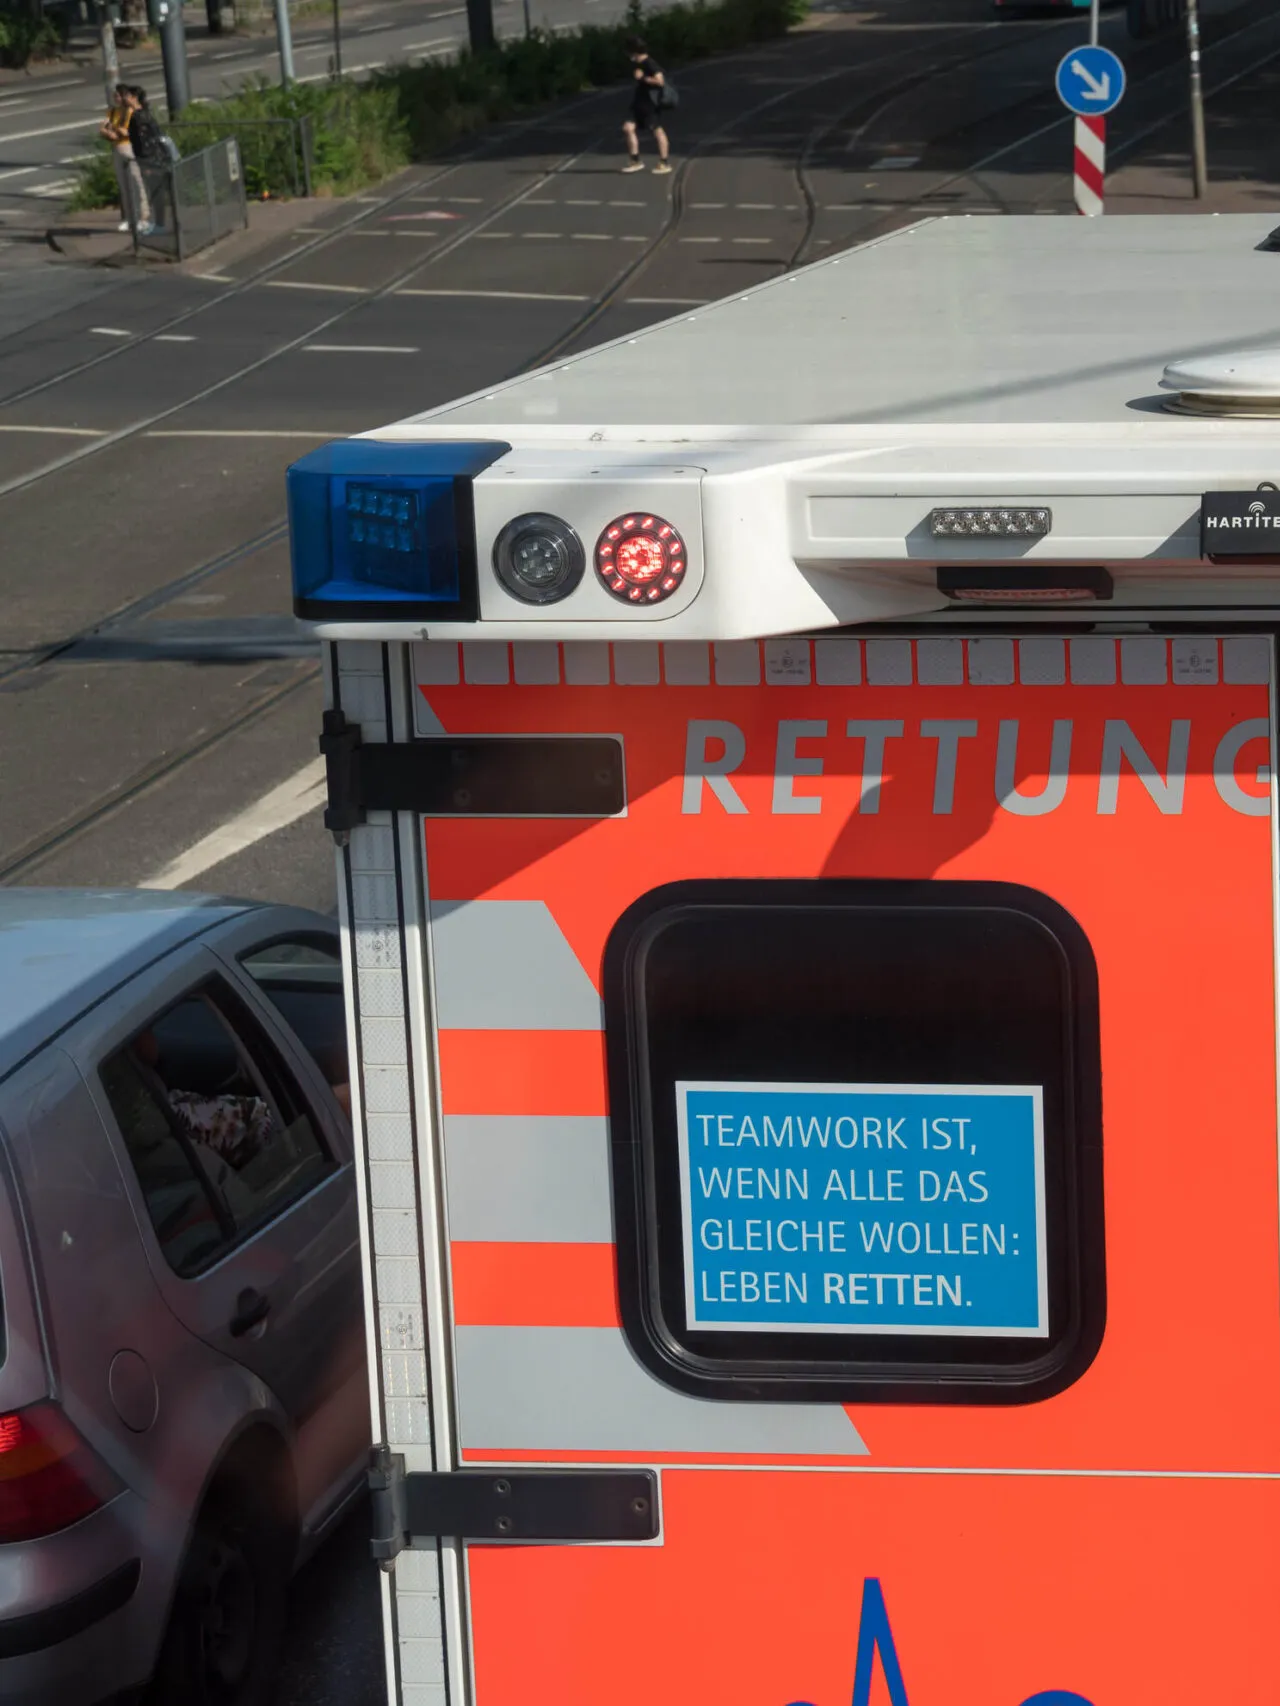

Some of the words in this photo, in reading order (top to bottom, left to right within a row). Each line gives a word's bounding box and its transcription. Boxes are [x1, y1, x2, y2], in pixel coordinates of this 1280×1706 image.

[696, 1114, 908, 1149] TEAMWORK
[922, 1117, 977, 1155] IST,
[698, 1167, 809, 1200] WENN
[823, 1169, 905, 1202] ALLE
[919, 1170, 989, 1203] DAS
[700, 1218, 847, 1253] GLEICHE
[859, 1221, 1019, 1256] WOLLEN:
[702, 1270, 808, 1304] LEBEN
[823, 1272, 973, 1307] RETTEN.
